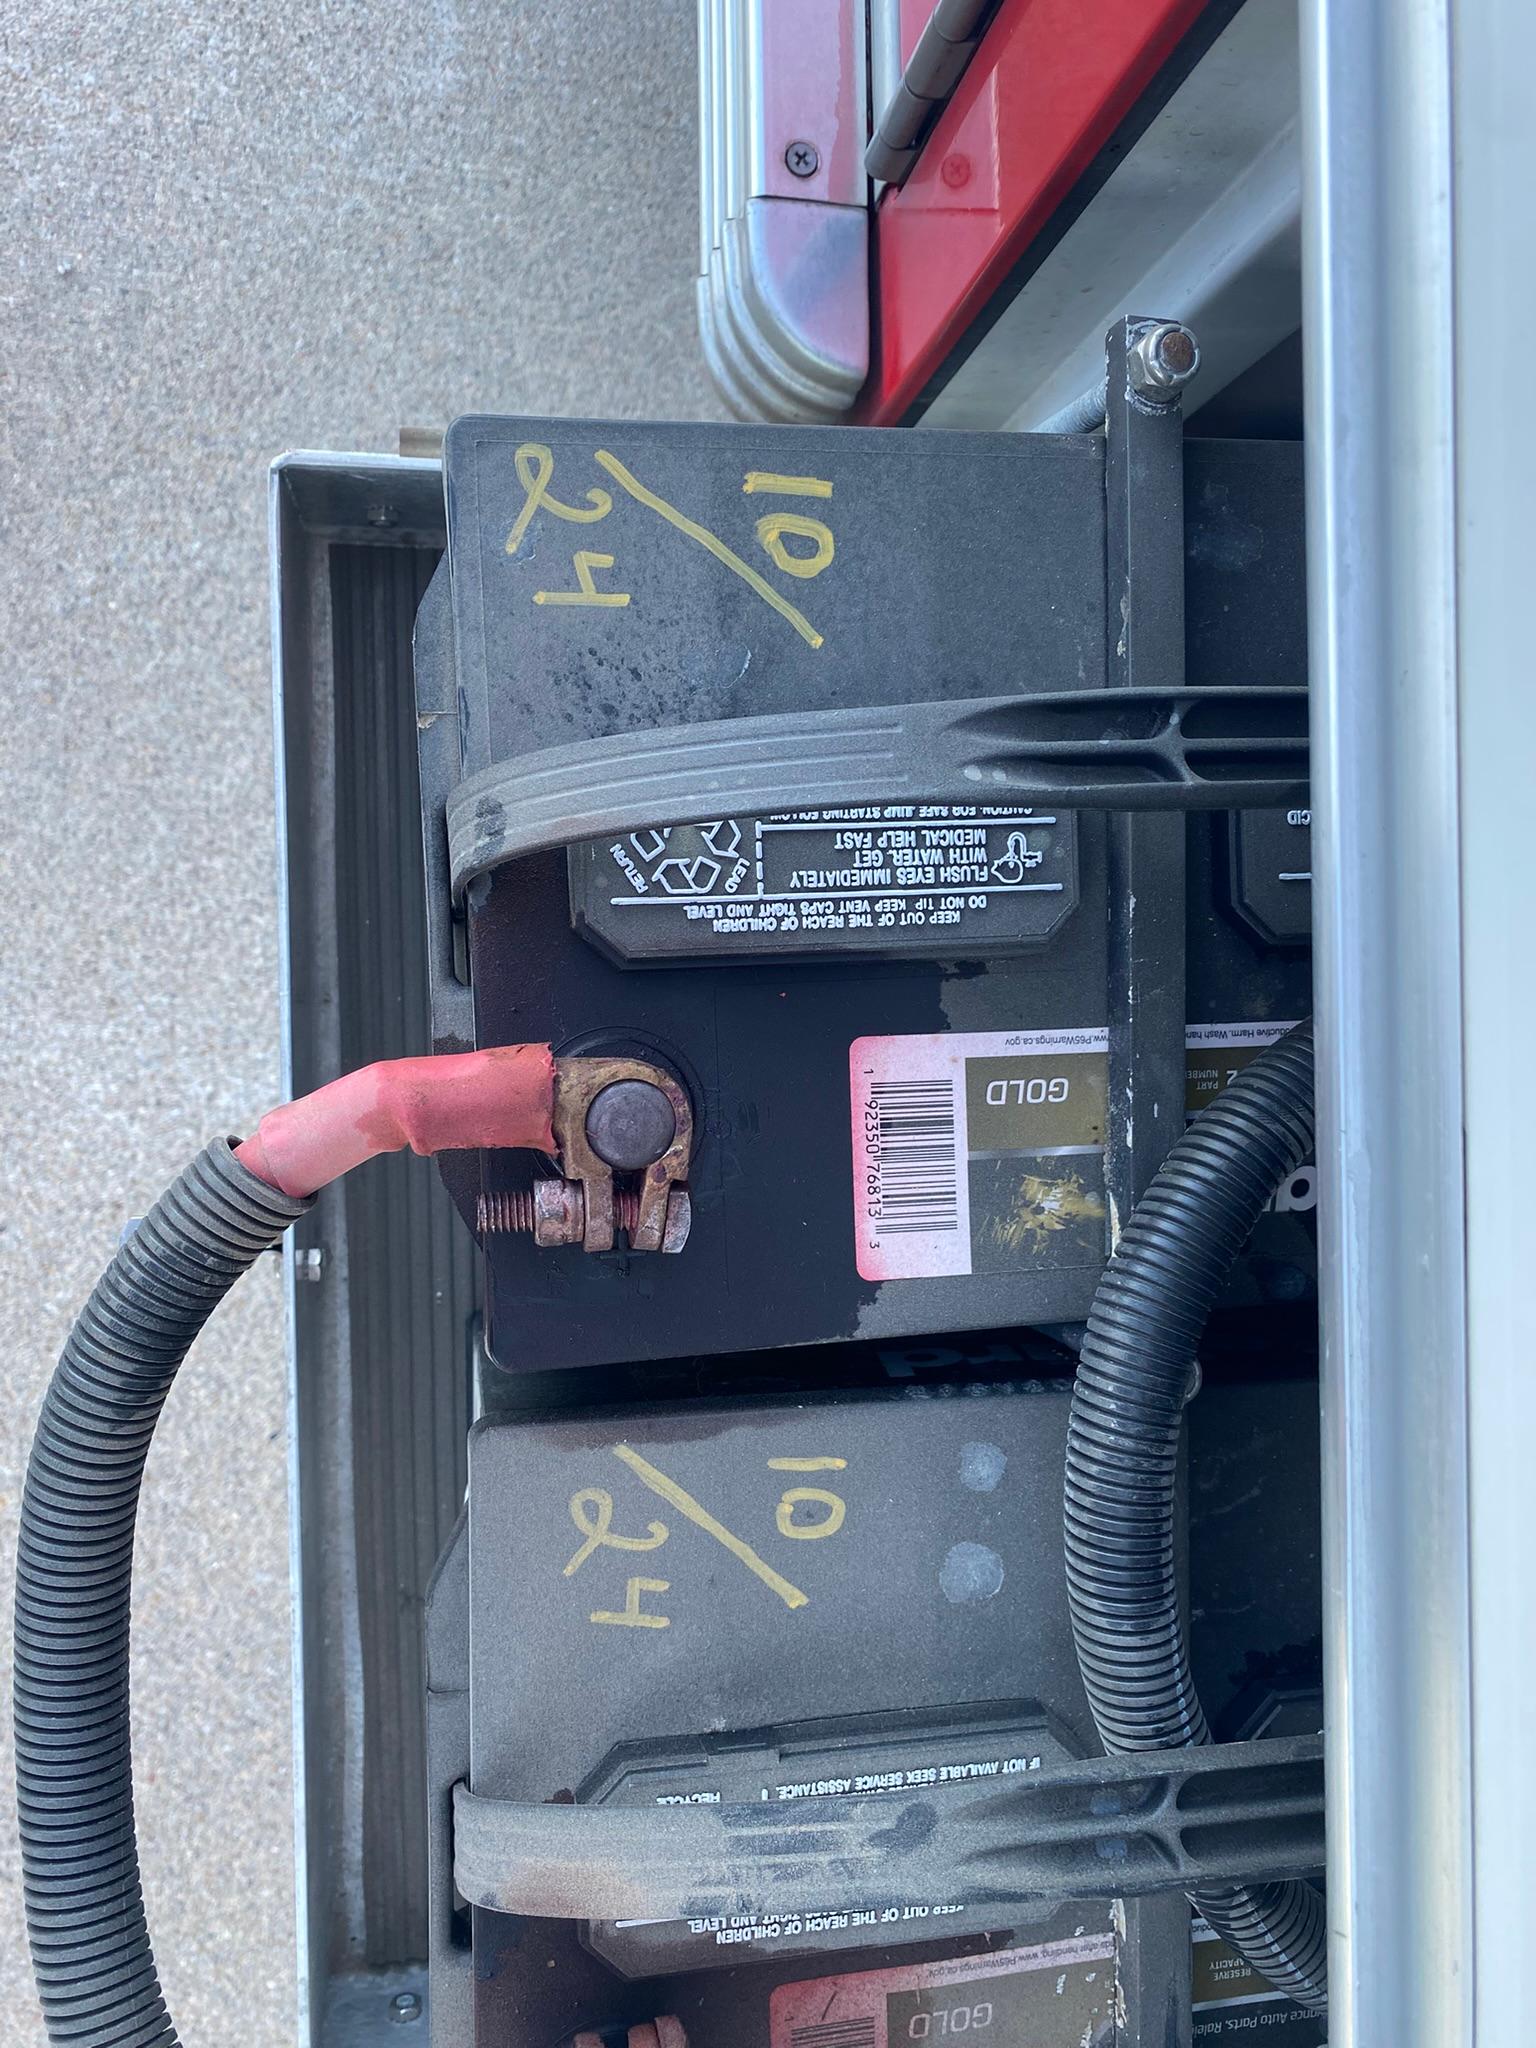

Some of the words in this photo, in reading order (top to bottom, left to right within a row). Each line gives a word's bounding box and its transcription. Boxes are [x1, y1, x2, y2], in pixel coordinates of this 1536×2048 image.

[834, 832, 872, 849] FAST
[877, 830, 916, 845] HELP
[921, 828, 986, 847] MEDICAL
[852, 850, 884, 868] GET
[948, 848, 987, 864] WITH
[609, 843, 649, 894] RETURN
[724, 857, 751, 894] LEAD
[895, 866, 935, 885] EYES
[939, 865, 988, 884] FLUSH
[789, 868, 891, 889] IMMEDIATELY
[799, 900, 834, 916] CAPS
[838, 899, 870, 914] VENT
[874, 898, 906, 912] KEEP
[915, 897, 934, 911] TIP
[940, 896, 964, 910] NOT
[968, 894, 987, 908] DO
[682, 904, 723, 920] LEVEL
[726, 903, 754, 919] AND
[758, 901, 796, 918] TIGHT
[928, 910, 960, 924] KEEP
[713, 916, 778, 933] CHILDREN
[780, 915, 799, 932] OF
[802, 914, 844, 930] REACH
[848, 914, 873, 928] THE
[877, 912, 895, 927] OF
[898, 911, 925, 926] OUT
[1185, 1031, 1203, 1041] han
[1203, 1030, 1228, 1041] Wash
[1229, 1029, 1255, 1039] Harm.
[863, 1068, 875, 1076] 1
[1185, 1069, 1218, 1079] NUMBE
[985, 1076, 1069, 1106] GOLD
[1196, 1080, 1219, 1090] PART
[864, 1100, 880, 1155] 92350
[866, 1163, 881, 1218] 76813
[869, 1240, 881, 1250] 3
[939, 1760, 999, 1780] AVAILABLE
[1001, 1758, 1026, 1773] NOT
[1029, 1756, 1041, 1769] IF
[854, 1771, 904, 1790] SERVICE
[906, 1767, 937, 1783] SEEK
[775, 1777, 852, 1799] ASSISTANCE.
[851, 1910, 877, 1926] THE
[880, 1907, 899, 1922] OF
[902, 1906, 929, 1920] OUT
[687, 1917, 727, 1934] LEVEL
[784, 1920, 802, 1935] OF
[805, 1914, 848, 1932] REACH
[715, 1922, 781, 1945] CHILDREN
[1213, 1967, 1251, 1982] RESERVE
[908, 2001, 993, 2038] GOLD
[1260, 2012, 1288, 2025] Auto
[1192, 2021, 1223, 2039] Ralei
